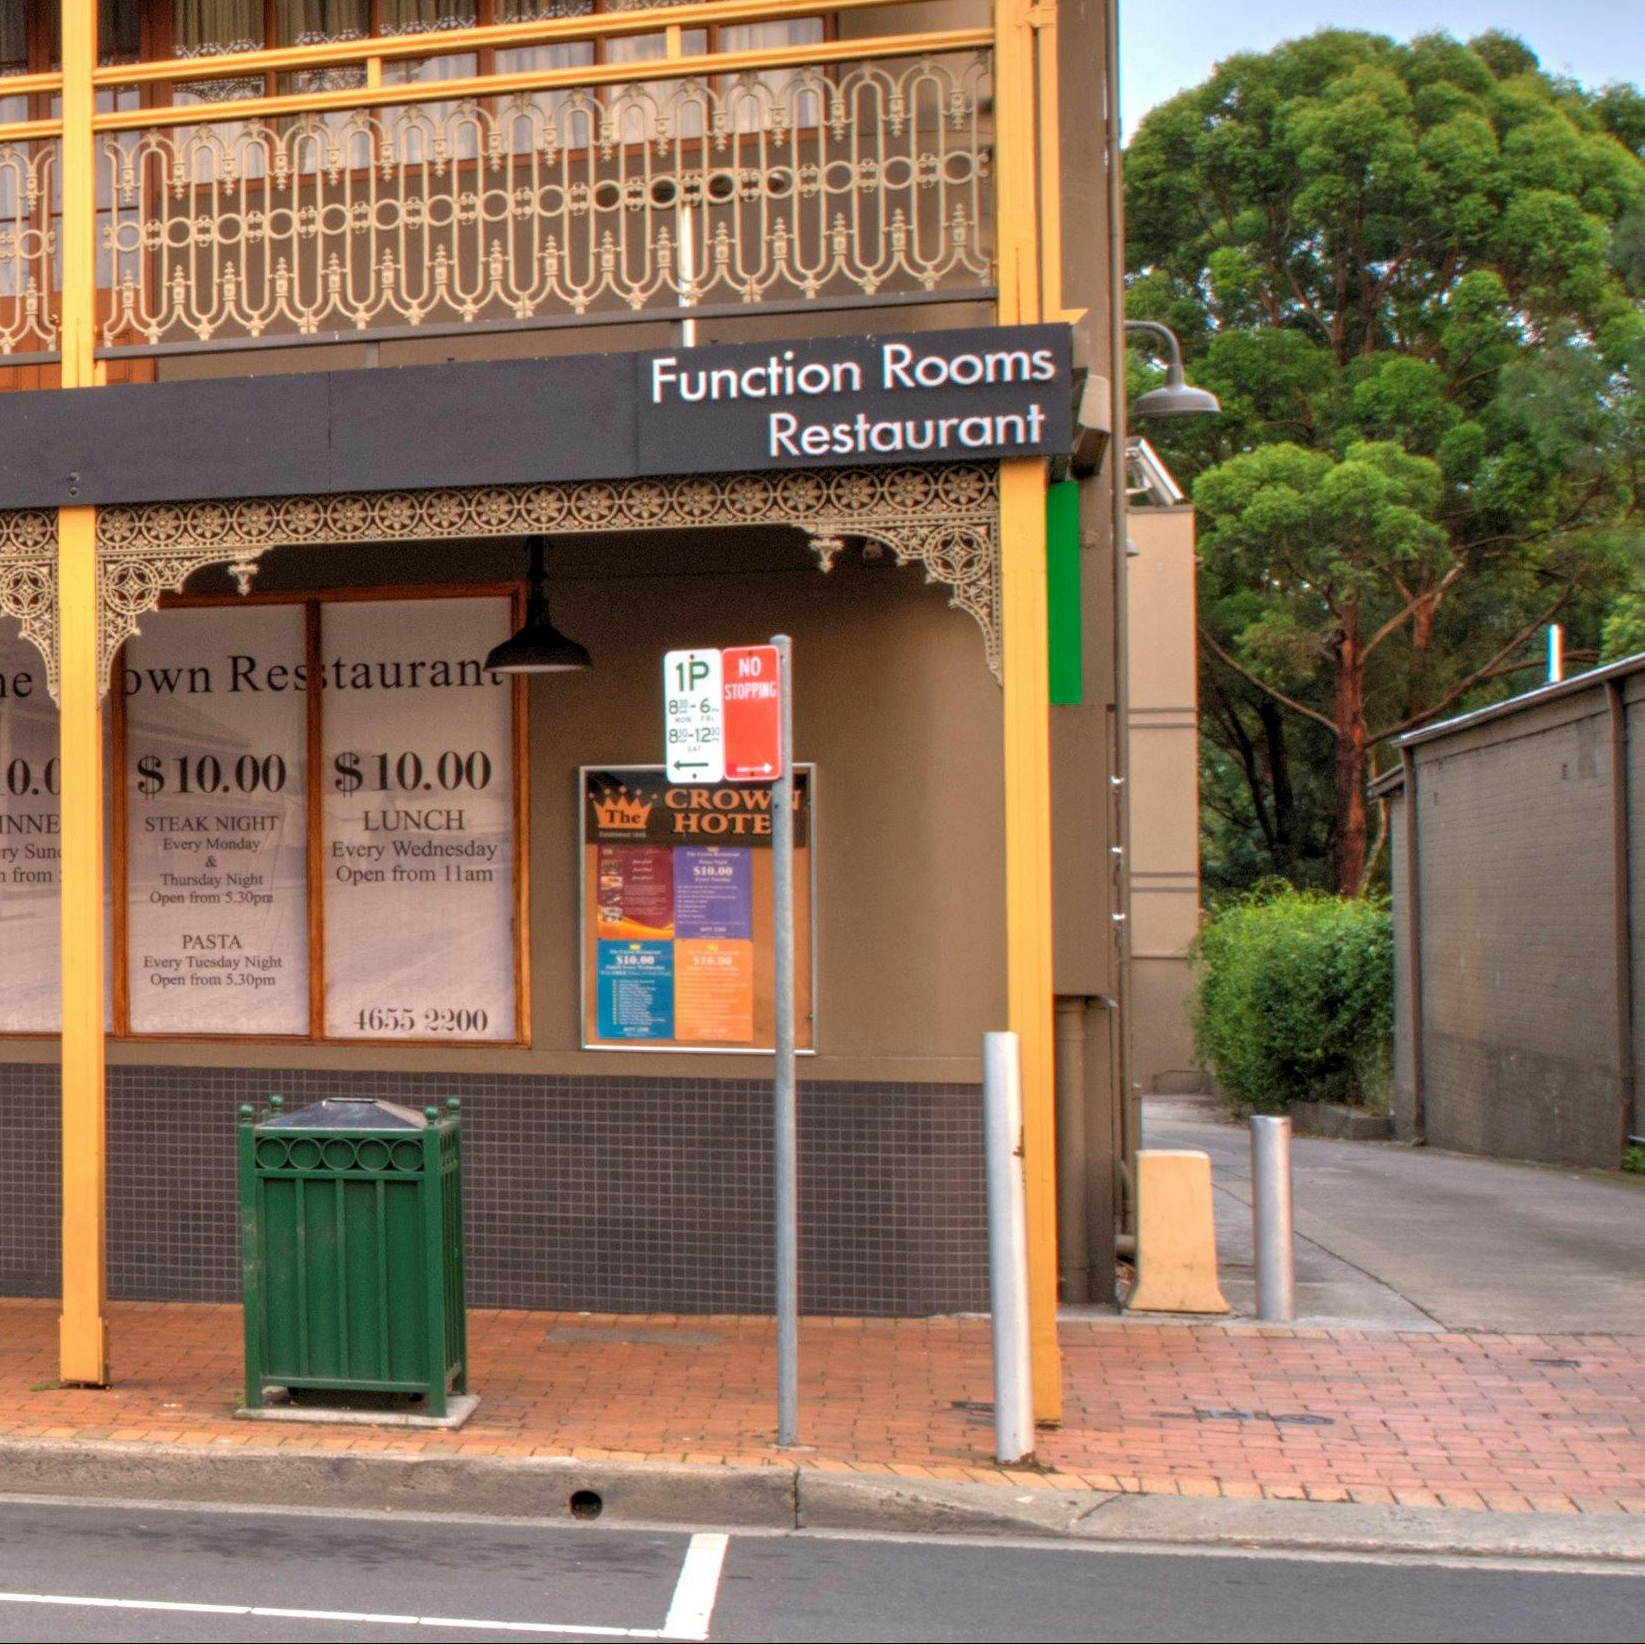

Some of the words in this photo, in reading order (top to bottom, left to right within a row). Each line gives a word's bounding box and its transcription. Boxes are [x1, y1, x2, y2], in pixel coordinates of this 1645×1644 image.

[652, 350, 862, 403] Function
[883, 344, 1056, 390] Rooms
[769, 404, 1046, 457] Restaurant
[738, 656, 762, 677] NO
[123, 666, 213, 696] own
[675, 661, 709, 692] 1P
[724, 681, 777, 700] STOPPING
[137, 754, 287, 800] $10.00
[334, 750, 492, 798] $10.00
[145, 816, 209, 833] STEAK
[215, 816, 279, 832] NIGHT
[362, 809, 465, 832] LUNCH
[605, 809, 641, 825] The
[672, 813, 772, 834] HOTE
[163, 838, 202, 852] Every
[205, 837, 261, 852] Monday
[331, 841, 386, 862] Every
[391, 840, 498, 862] Wednesday
[205, 856, 217, 868] &
[693, 866, 733, 877] $10.00
[12, 867, 53, 883] from
[160, 873, 221, 889] Thursday
[226, 873, 263, 889] Night
[336, 866, 388, 886] Open
[392, 865, 436, 883] from
[442, 865, 493, 883] 11am
[149, 891, 185, 905] Open
[189, 890, 220, 904] from
[225, 891, 274, 906] 5.30pm
[182, 934, 242, 950] PASTA
[143, 956, 182, 971] Every
[186, 955, 241, 971] Tuesday
[245, 955, 283, 971] Night
[616, 955, 655, 965] $10.00
[150, 973, 186, 987] Open
[190, 973, 221, 986] from
[225, 974, 276, 989] 5.30pm
[352, 1009, 415, 1033] 4655
[424, 1008, 489, 1033] 2200
